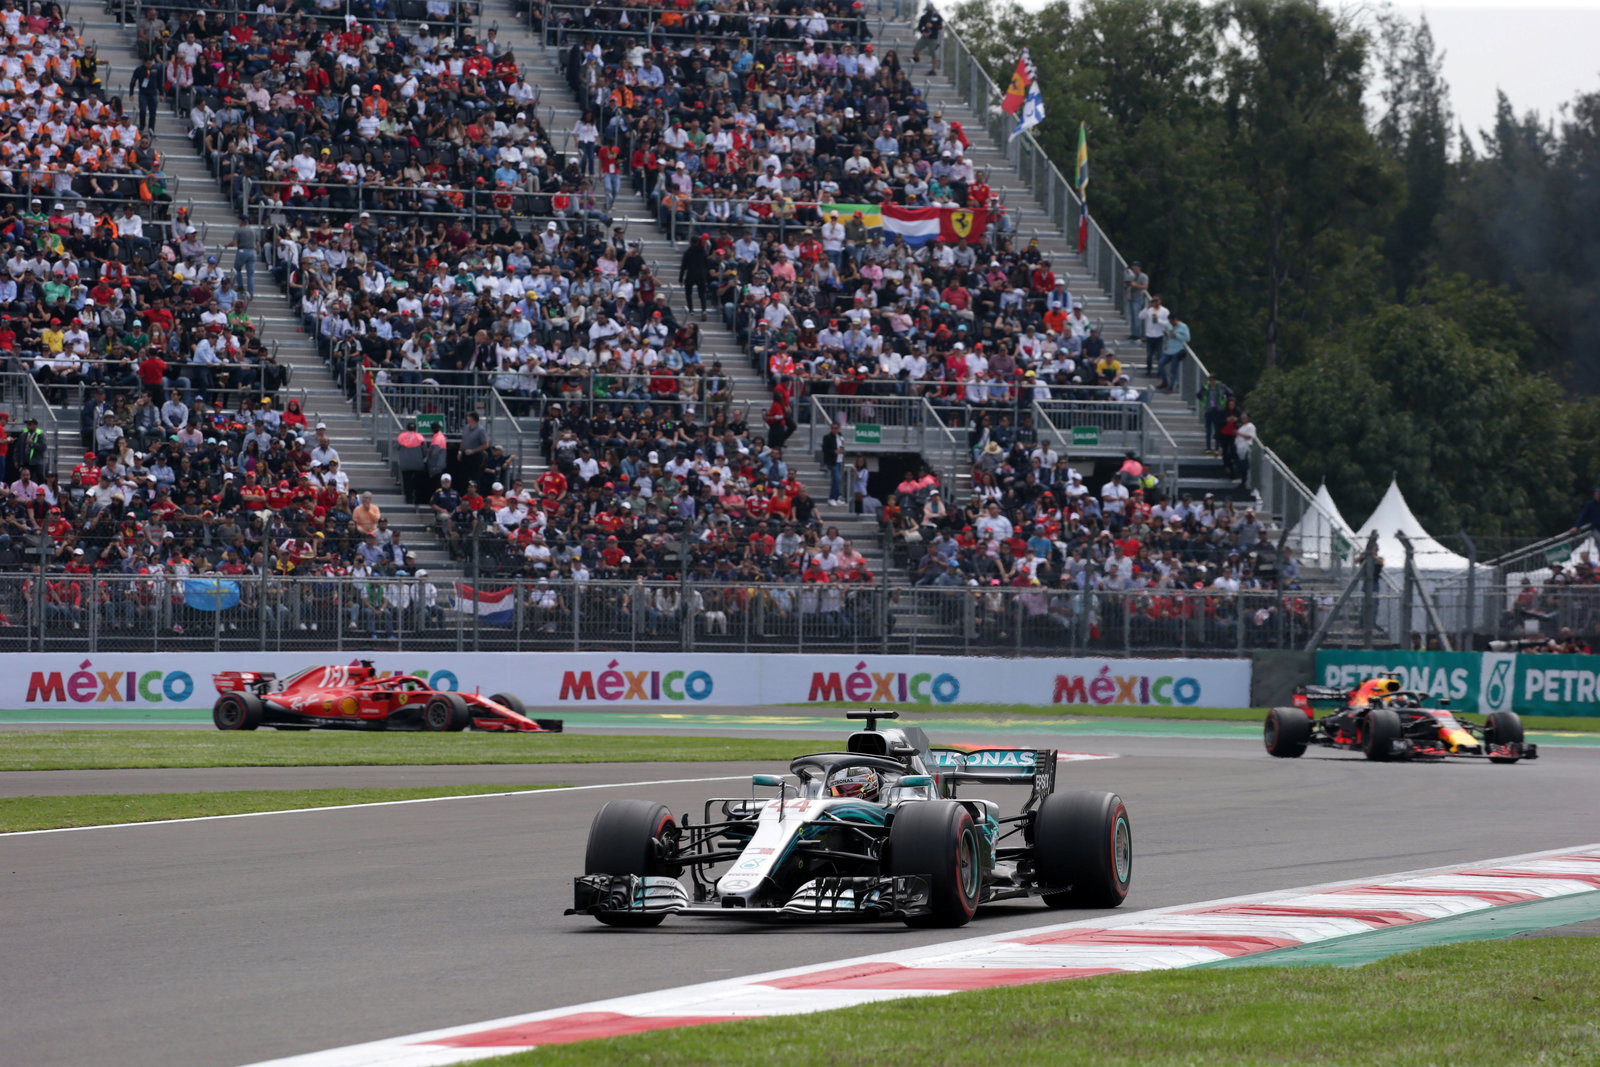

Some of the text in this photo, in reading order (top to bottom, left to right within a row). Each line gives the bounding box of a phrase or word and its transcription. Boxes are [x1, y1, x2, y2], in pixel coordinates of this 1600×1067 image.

[1525, 668, 1600, 702] PETR
[932, 751, 1035, 765] TRONAS
[768, 800, 811, 812] 44
